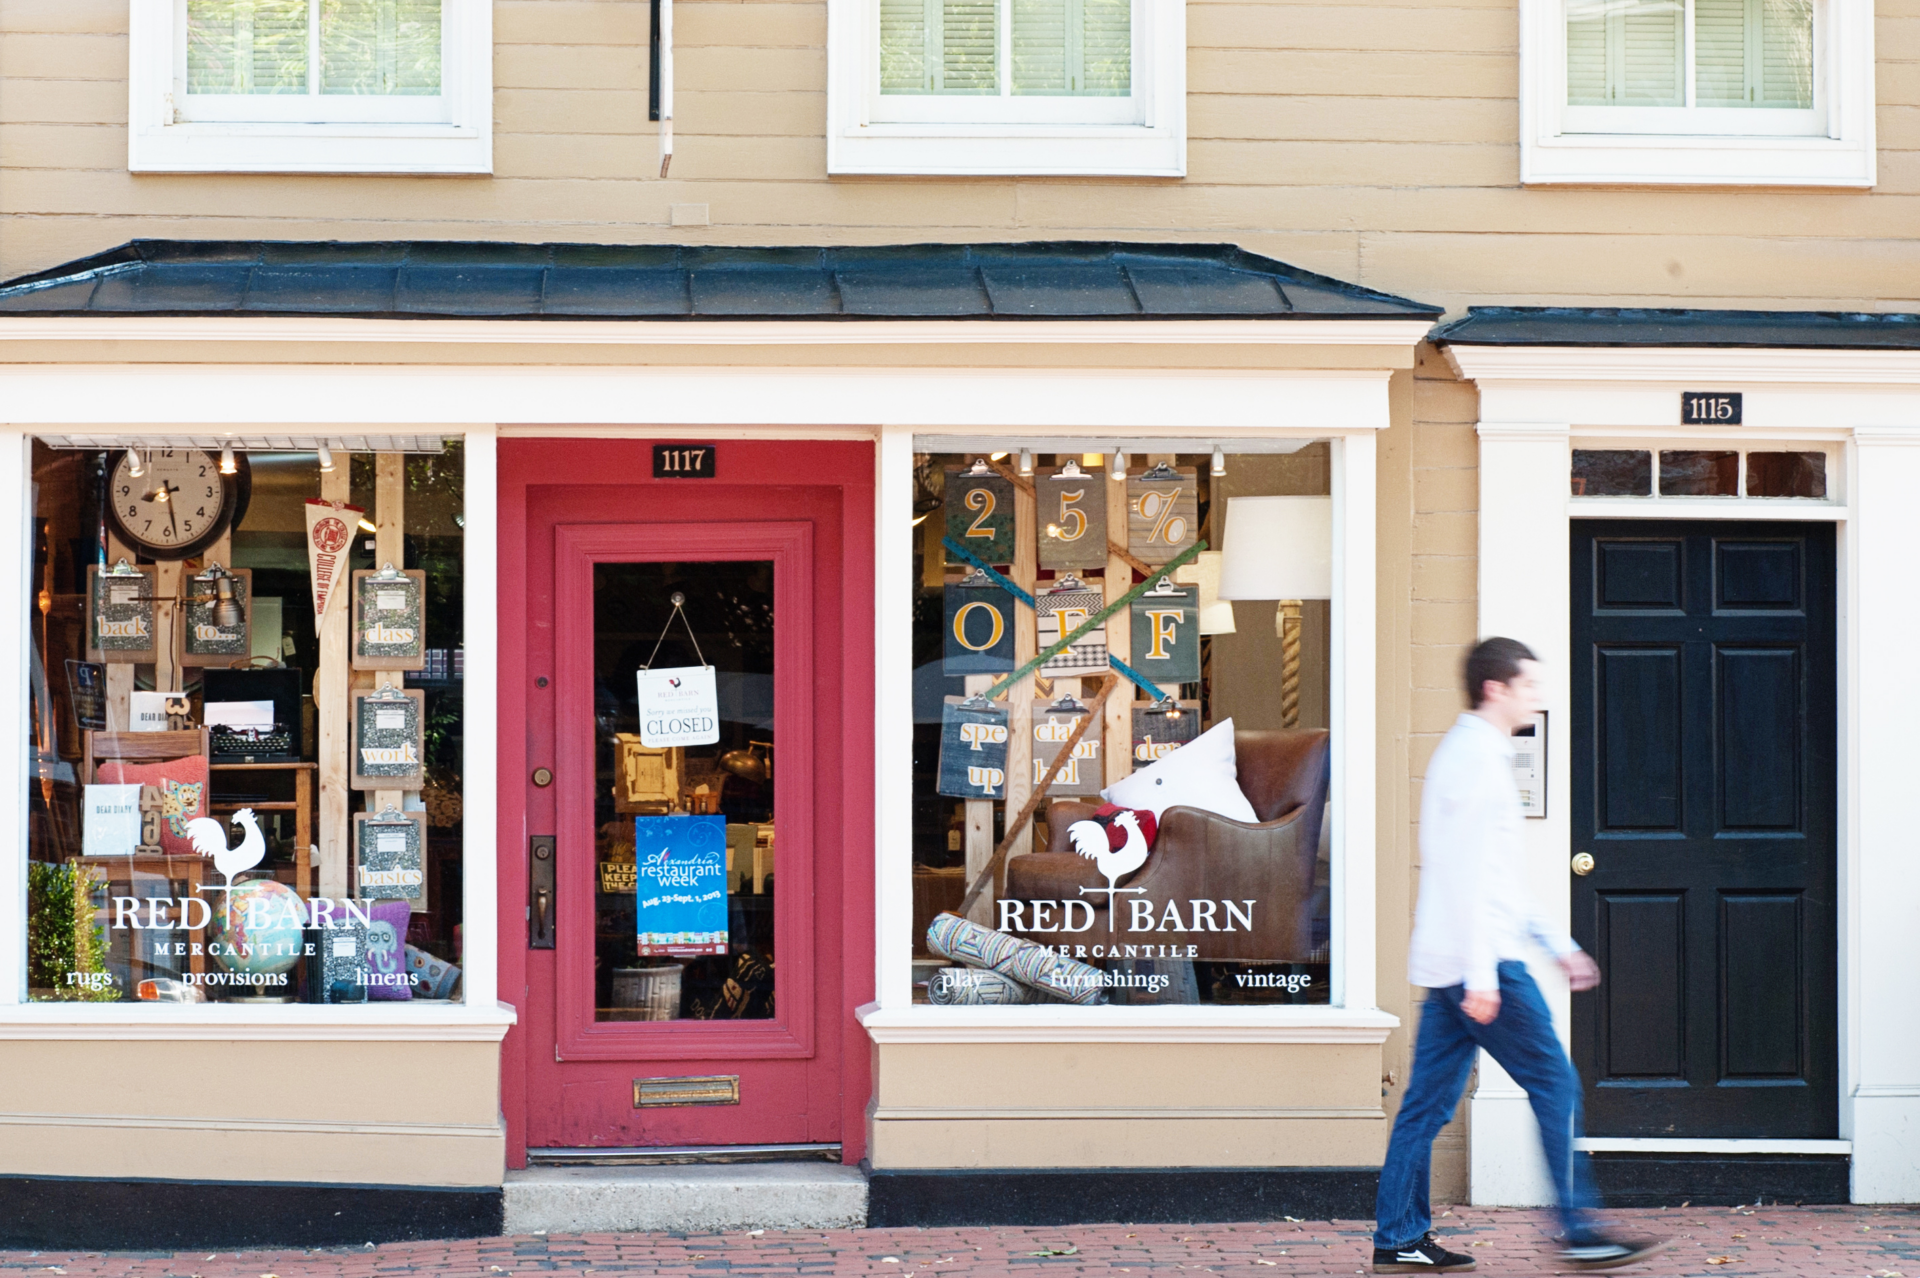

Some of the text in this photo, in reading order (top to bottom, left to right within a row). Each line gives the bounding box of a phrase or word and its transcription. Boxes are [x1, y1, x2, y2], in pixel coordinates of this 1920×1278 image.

[1690, 397, 1733, 420] 1115
[661, 449, 706, 471] 1117
[198, 465, 206, 477] 2
[122, 486, 130, 497] 9
[206, 486, 213, 498] 3
[128, 505, 137, 517] 8
[196, 506, 205, 517] 4
[144, 520, 152, 532] 7
[162, 526, 172, 537] 6
[184, 520, 192, 532] 5
[316, 553, 337, 582] COLLEGE
[99, 617, 147, 636] back
[365, 623, 413, 642] class
[140, 712, 156, 722] DEAR
[646, 716, 714, 736] CLOSED
[961, 724, 1005, 749] spe
[363, 743, 416, 763] work
[970, 768, 1003, 793] up
[96, 805, 112, 814] DEAR
[360, 866, 422, 886] basics
[604, 873, 637, 882] KEEP
[606, 864, 637, 873] PLEA
[641, 863, 722, 878] restaurant
[657, 874, 699, 887] week
[642, 896, 661, 909] Aug.
[661, 893, 695, 905] 23-Sept.
[702, 890, 721, 902] 2013
[112, 896, 376, 930] RED BARN
[996, 898, 1257, 933] RED BARN
[154, 942, 317, 956] MERCANTILE
[1039, 944, 1199, 958] MERCANTILE
[65, 970, 113, 992] rugs
[181, 967, 288, 987] provisions
[354, 967, 419, 986] linens
[941, 969, 984, 994] play
[1050, 968, 1170, 994] furnishings
[1235, 969, 1312, 993] vintage
